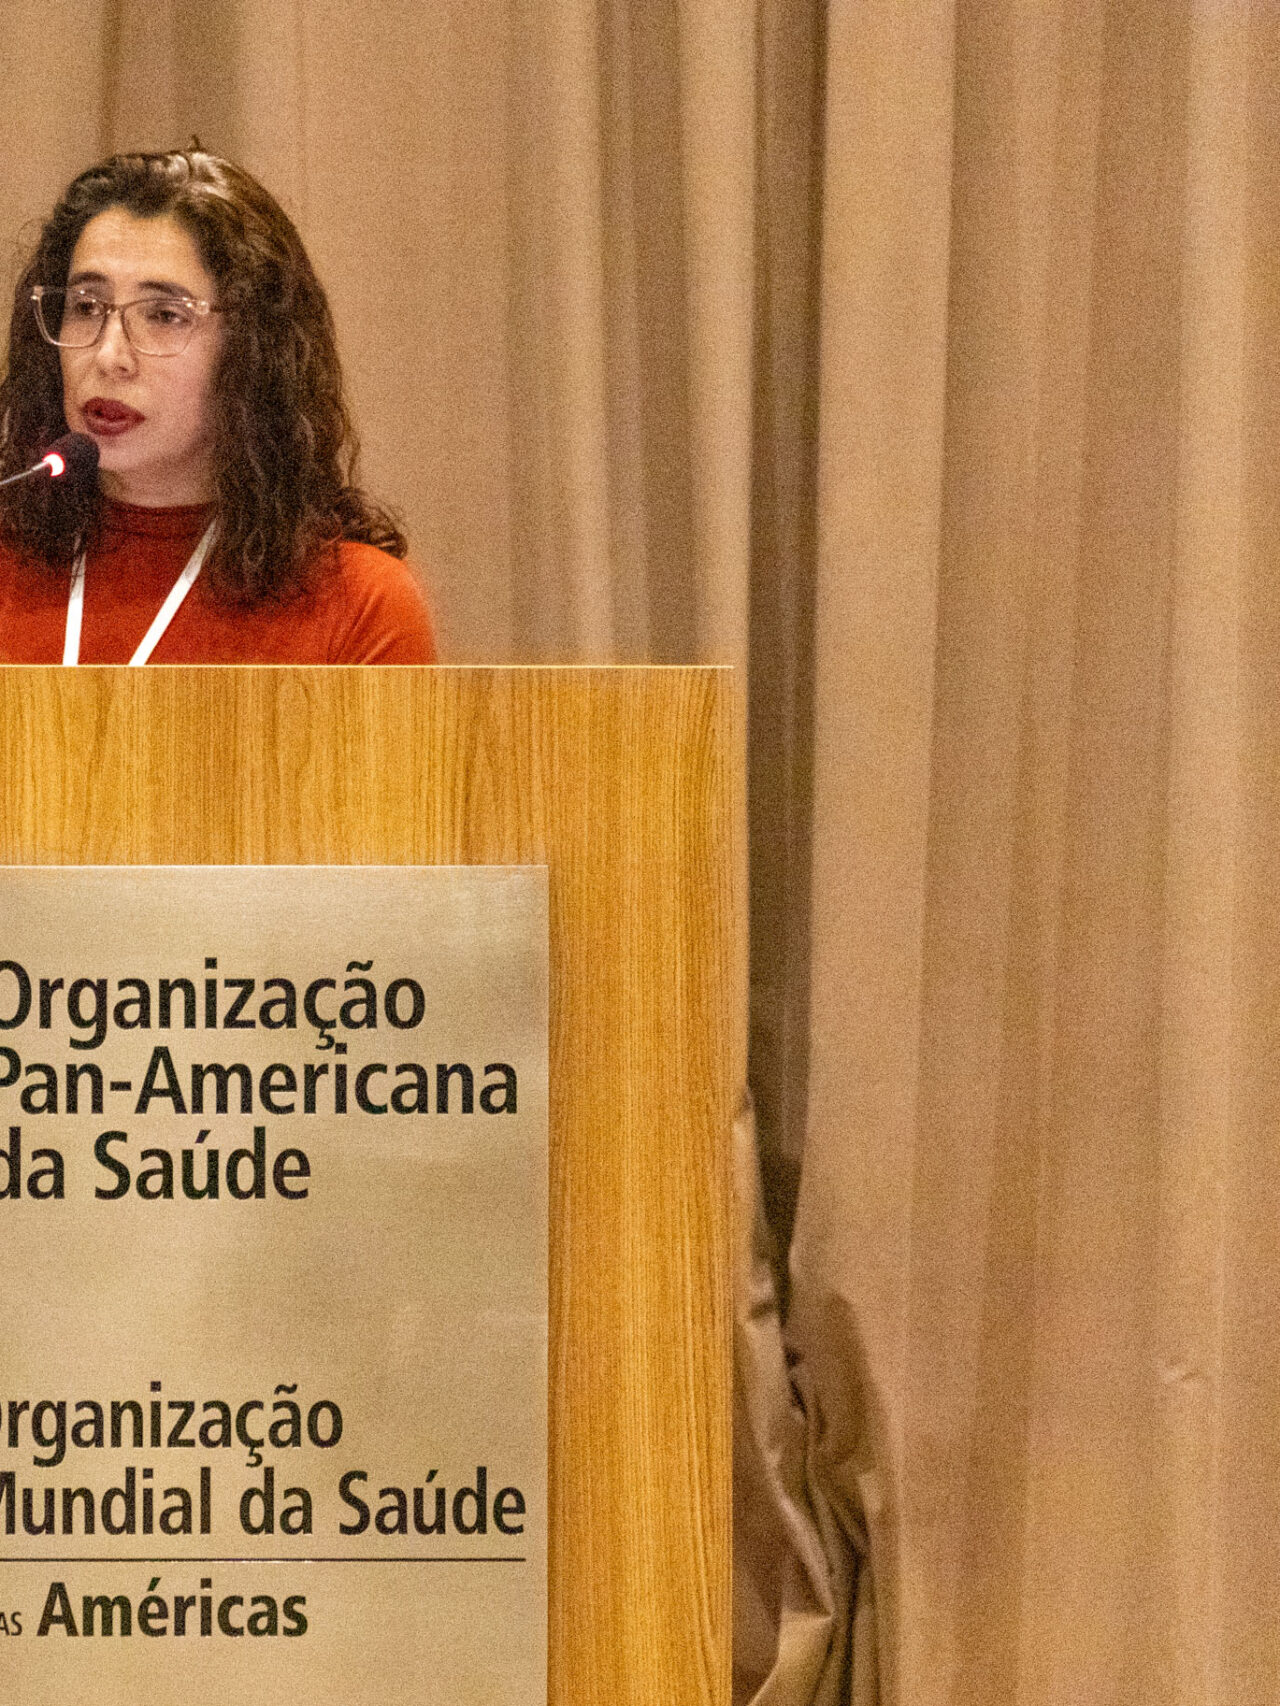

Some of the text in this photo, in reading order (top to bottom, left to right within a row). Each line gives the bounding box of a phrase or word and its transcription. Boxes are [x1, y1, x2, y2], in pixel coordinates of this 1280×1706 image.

[95, 1127, 310, 1199] Saúde
[240, 1467, 312, 1534] da
[339, 1466, 526, 1535] Saúde
[38, 1578, 307, 1636] Américas
